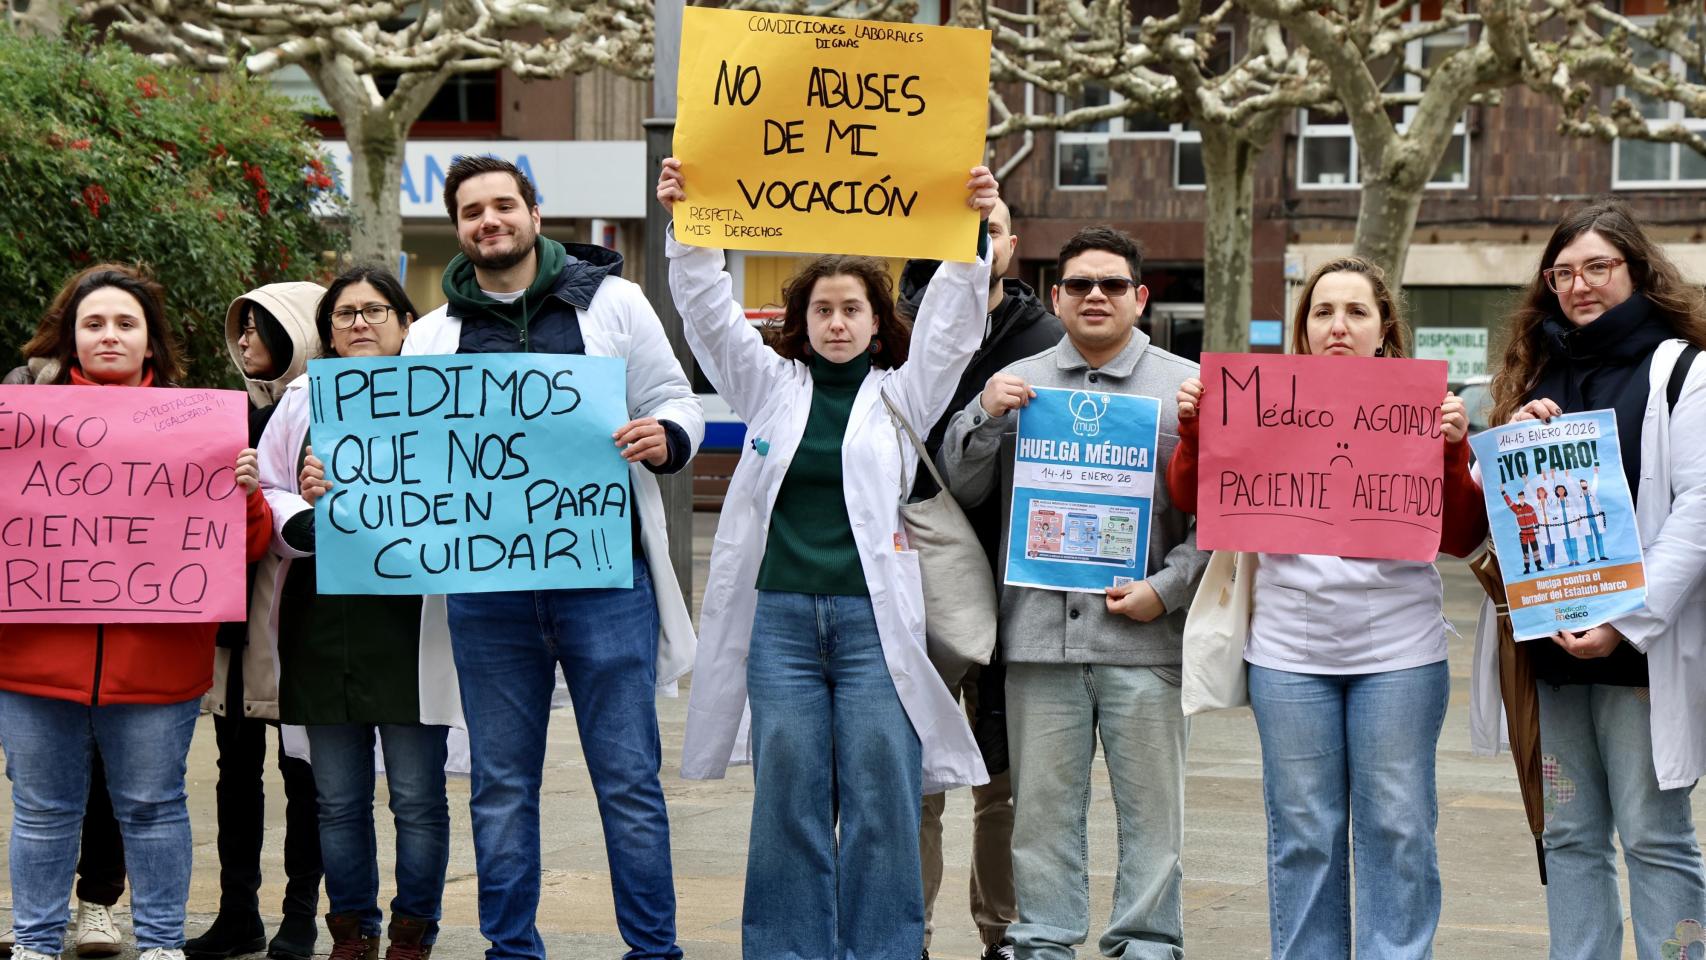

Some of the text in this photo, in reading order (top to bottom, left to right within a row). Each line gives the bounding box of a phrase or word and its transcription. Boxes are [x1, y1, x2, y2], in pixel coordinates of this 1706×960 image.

[748, 15, 924, 43] CONDICIONES LABORALES
[815, 38, 860, 49] DIGNAS
[713, 60, 926, 117] NO ABUSES
[763, 119, 879, 157] DE MI
[736, 174, 919, 217] VOCACIÓN
[684, 224, 783, 238] MIS DERECHOS
[689, 206, 744, 222] RESPETA
[1418, 333, 1485, 348] DISPONIBLE
[1221, 365, 1334, 428] Médico
[1499, 422, 1595, 446] 14-15 ENERO 2026
[331, 429, 530, 486] QUE NOS
[1020, 437, 1148, 468] HUELGA MÉDICA
[1497, 440, 1600, 484] ¡YO PARO!
[21, 460, 238, 501] AGOTADO
[1041, 467, 1131, 483] 14-15 ENERO 26
[328, 478, 627, 534] CUIDEN PARA
[1352, 473, 1443, 517] AFECTADO
[181, 516, 228, 551] EN
[6, 559, 208, 607] RIESGO
[1521, 580, 1628, 605] Borrador del Estatuto Marco
[1536, 571, 1601, 590] Huelga contra el
